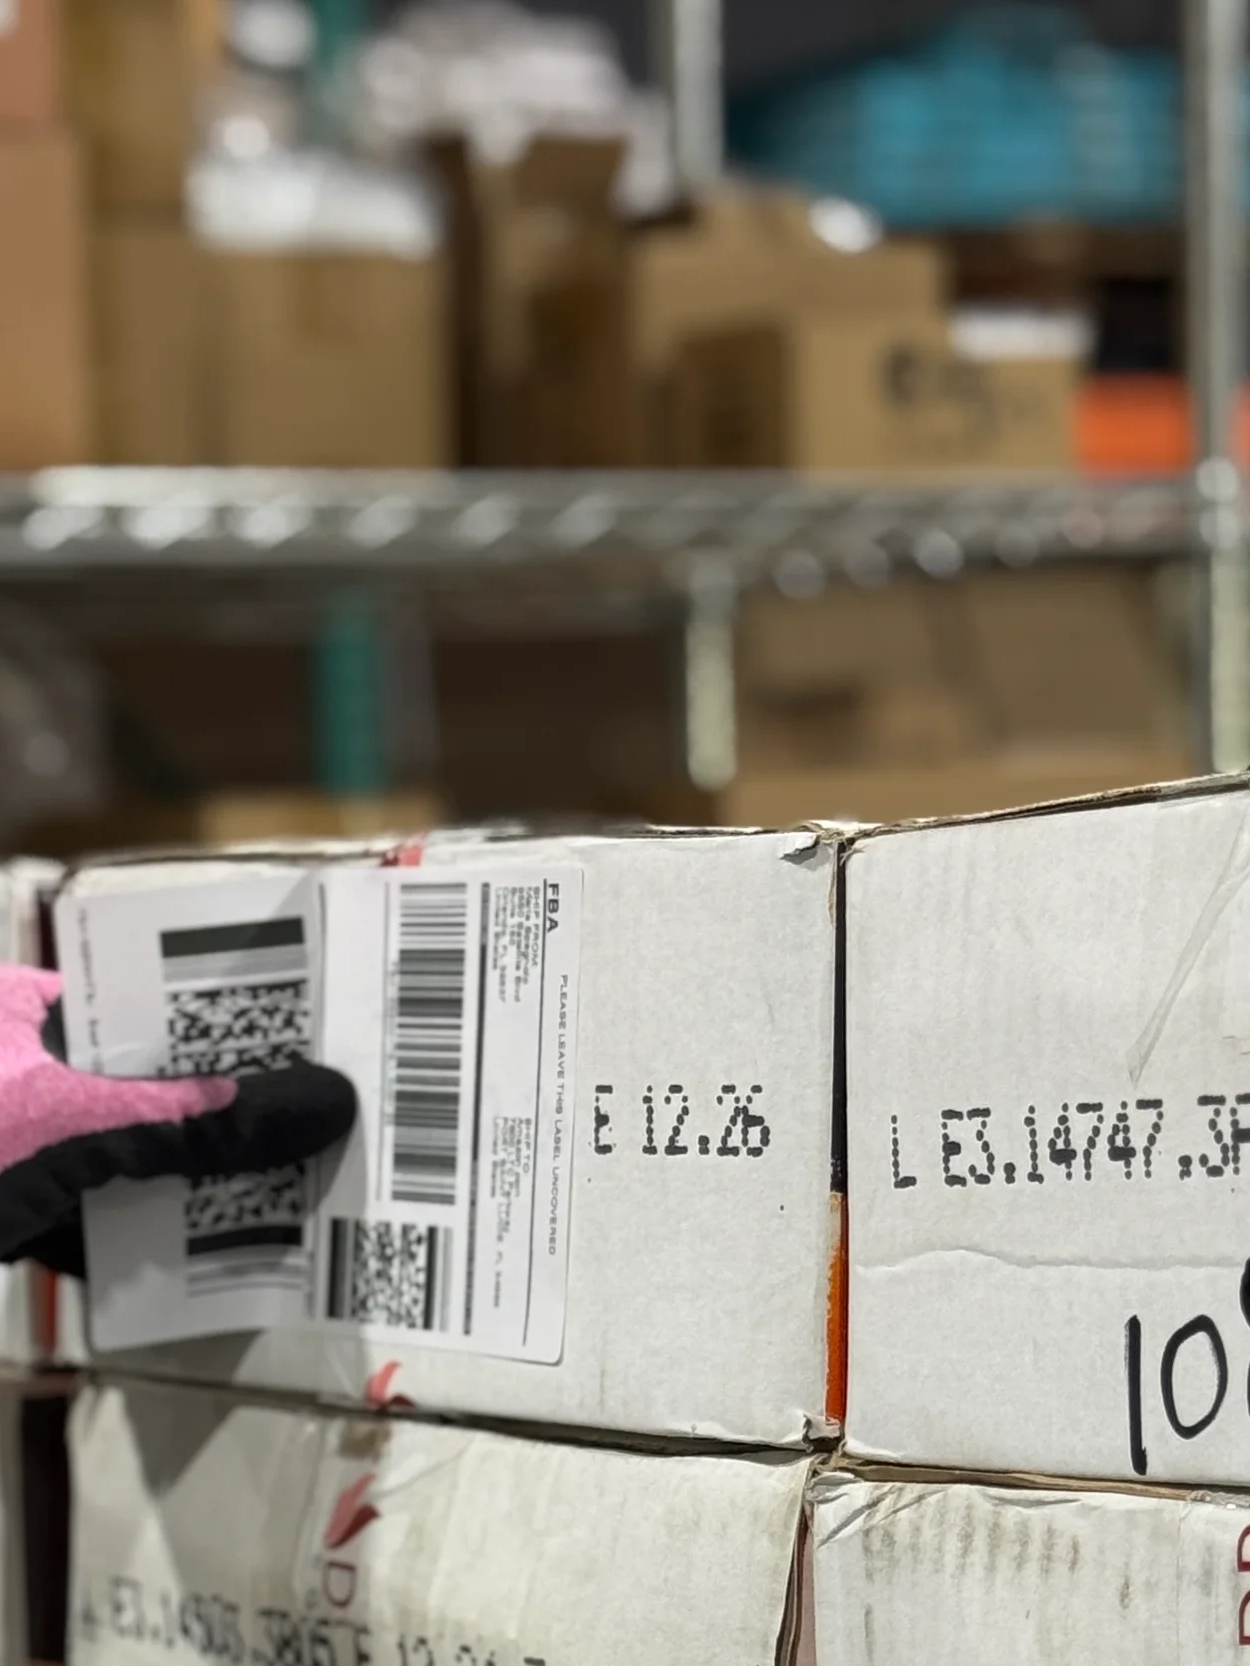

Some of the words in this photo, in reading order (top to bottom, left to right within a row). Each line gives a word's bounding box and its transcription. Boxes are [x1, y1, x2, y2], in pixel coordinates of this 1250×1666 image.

[546, 882, 560, 933] FBA
[558, 975, 569, 1029] PLEASE
[556, 1034, 567, 1079] LEAVE
[554, 1084, 565, 1115] THIS
[594, 1084, 613, 1155] E
[641, 1084, 771, 1158] 12.26
[552, 1119, 563, 1162] LABEL
[890, 1113, 918, 1189] L
[547, 1166, 561, 1256] UNCOVERED
[1123, 1256, 1250, 1476] 10
